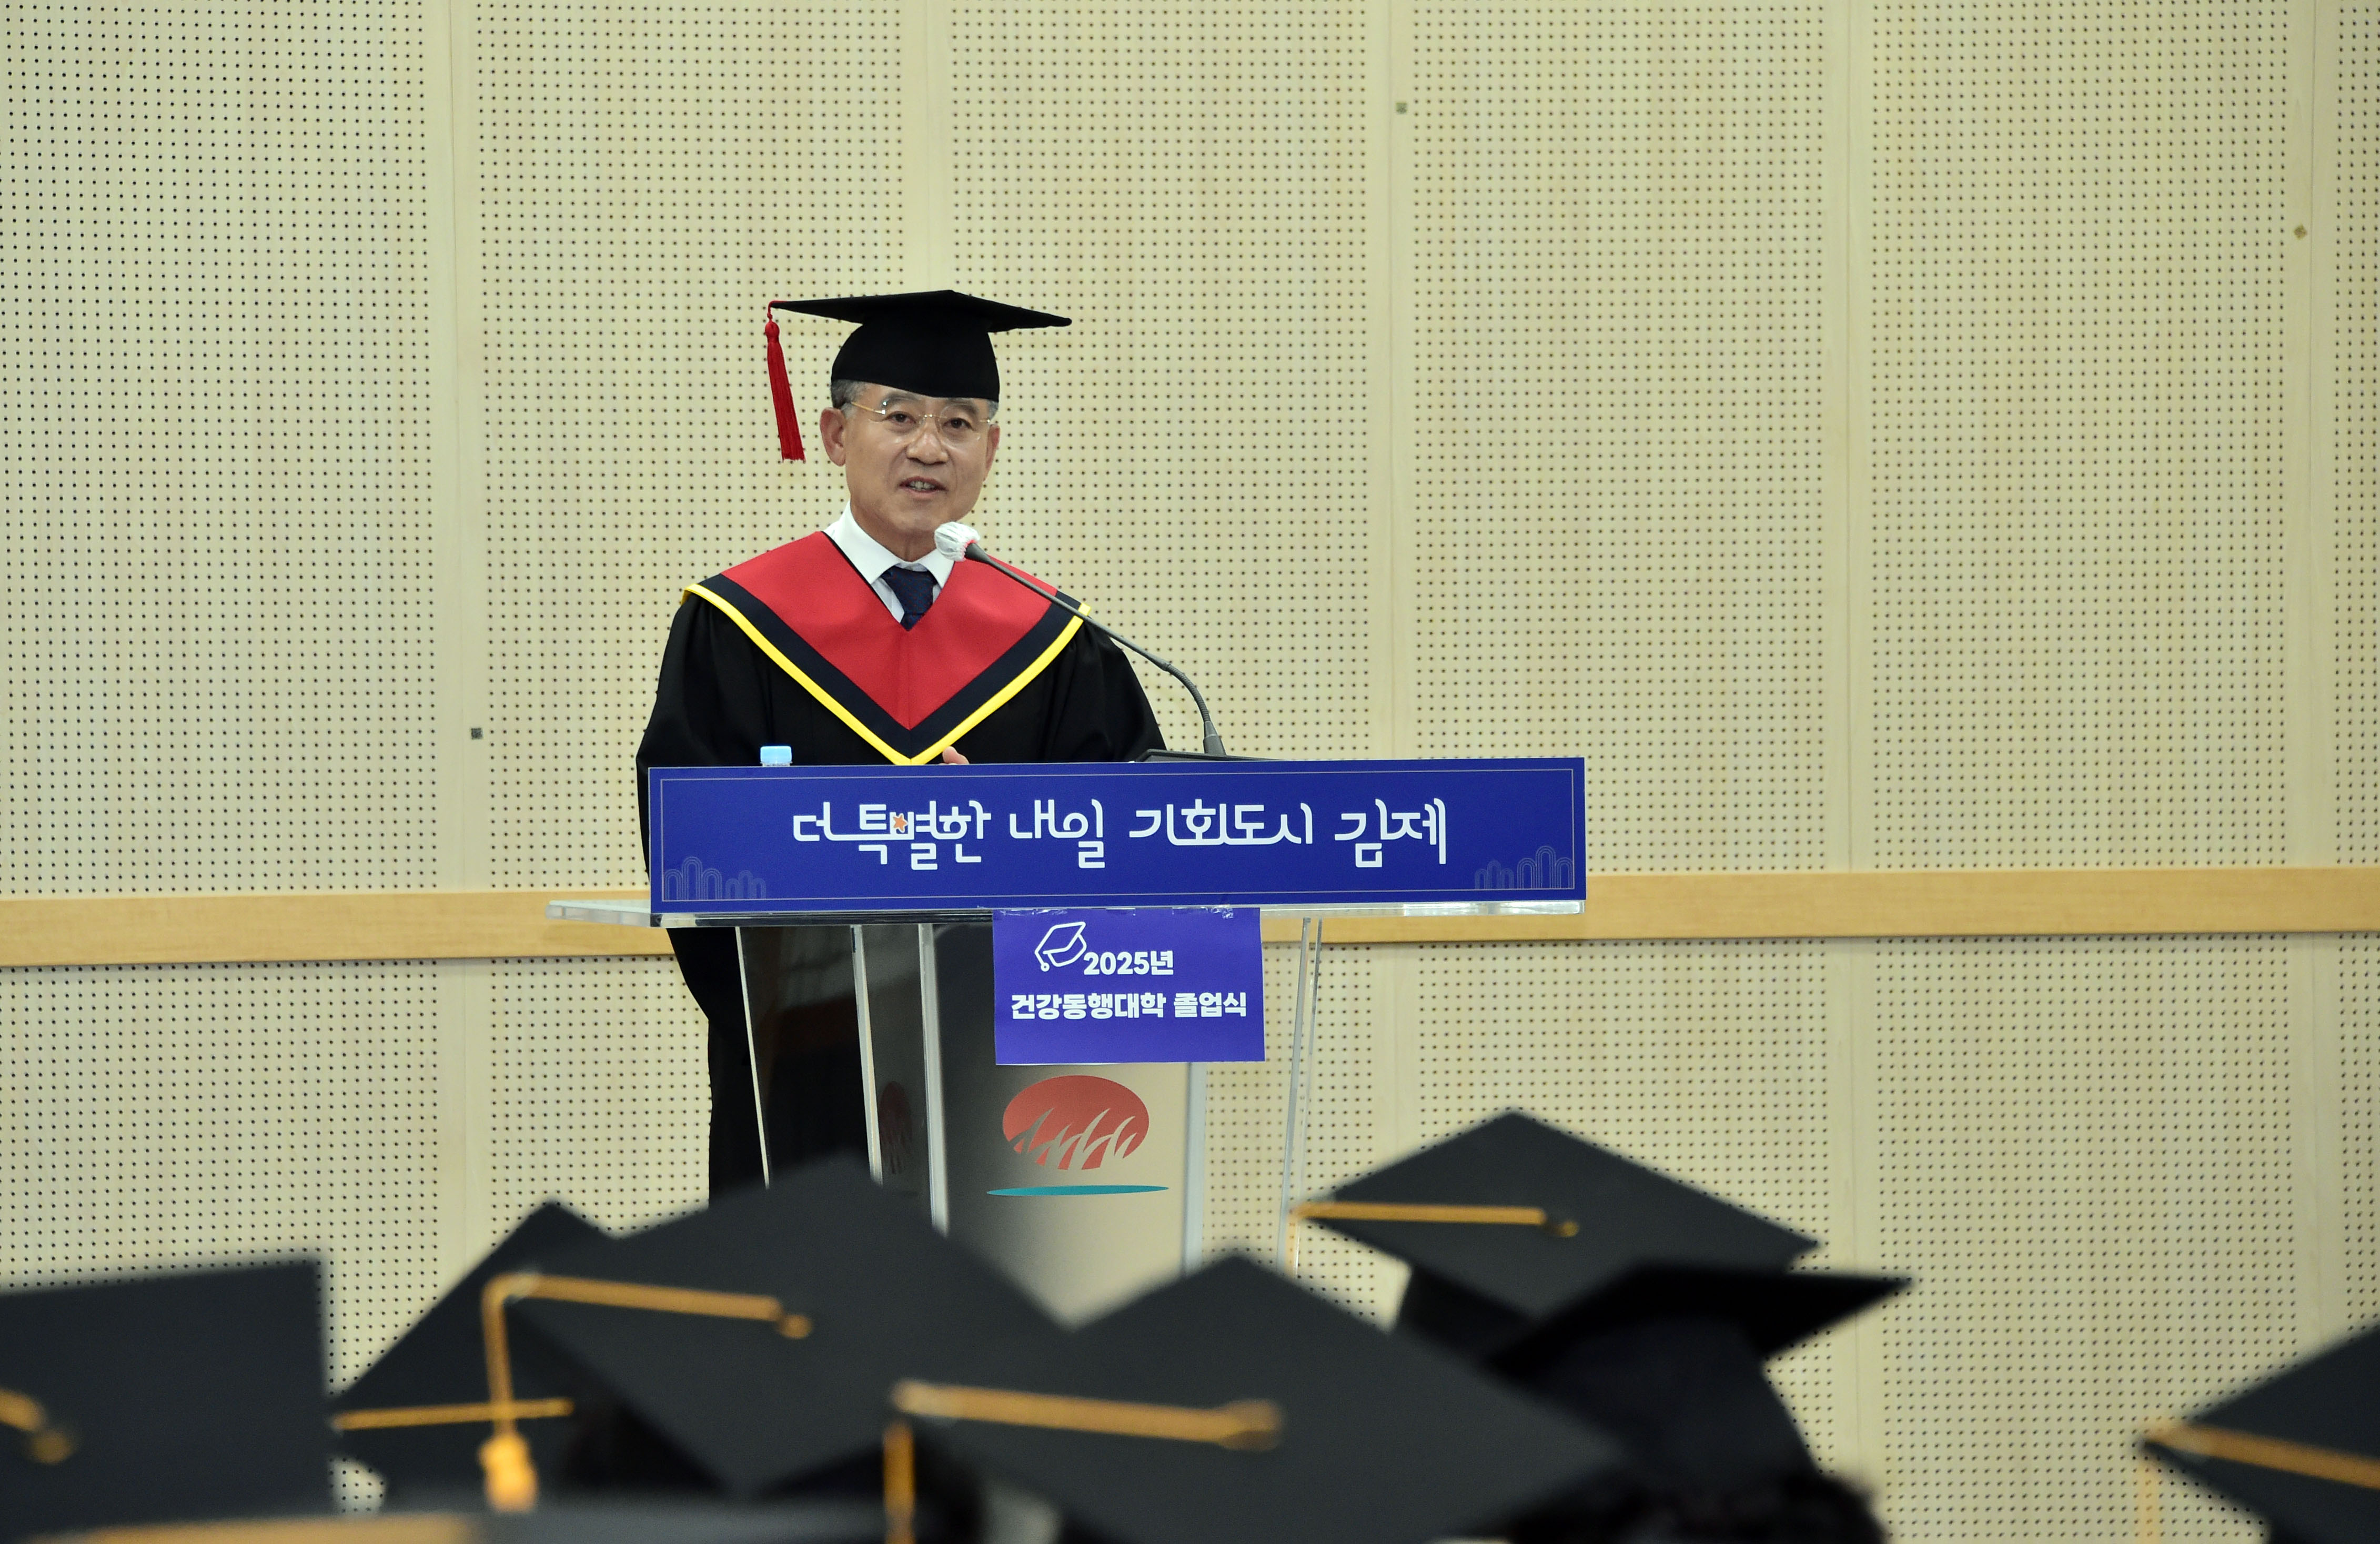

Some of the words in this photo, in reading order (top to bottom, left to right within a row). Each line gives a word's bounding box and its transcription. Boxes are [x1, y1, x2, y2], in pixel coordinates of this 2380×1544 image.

[1009, 799, 1105, 869] 내일
[1128, 799, 1313, 846] 기회도시
[1334, 798, 1446, 868] 김제
[1083, 950, 1174, 976] 2025년
[1011, 992, 1167, 1020] 건강동행대학
[1173, 992, 1247, 1018] 졸업식
